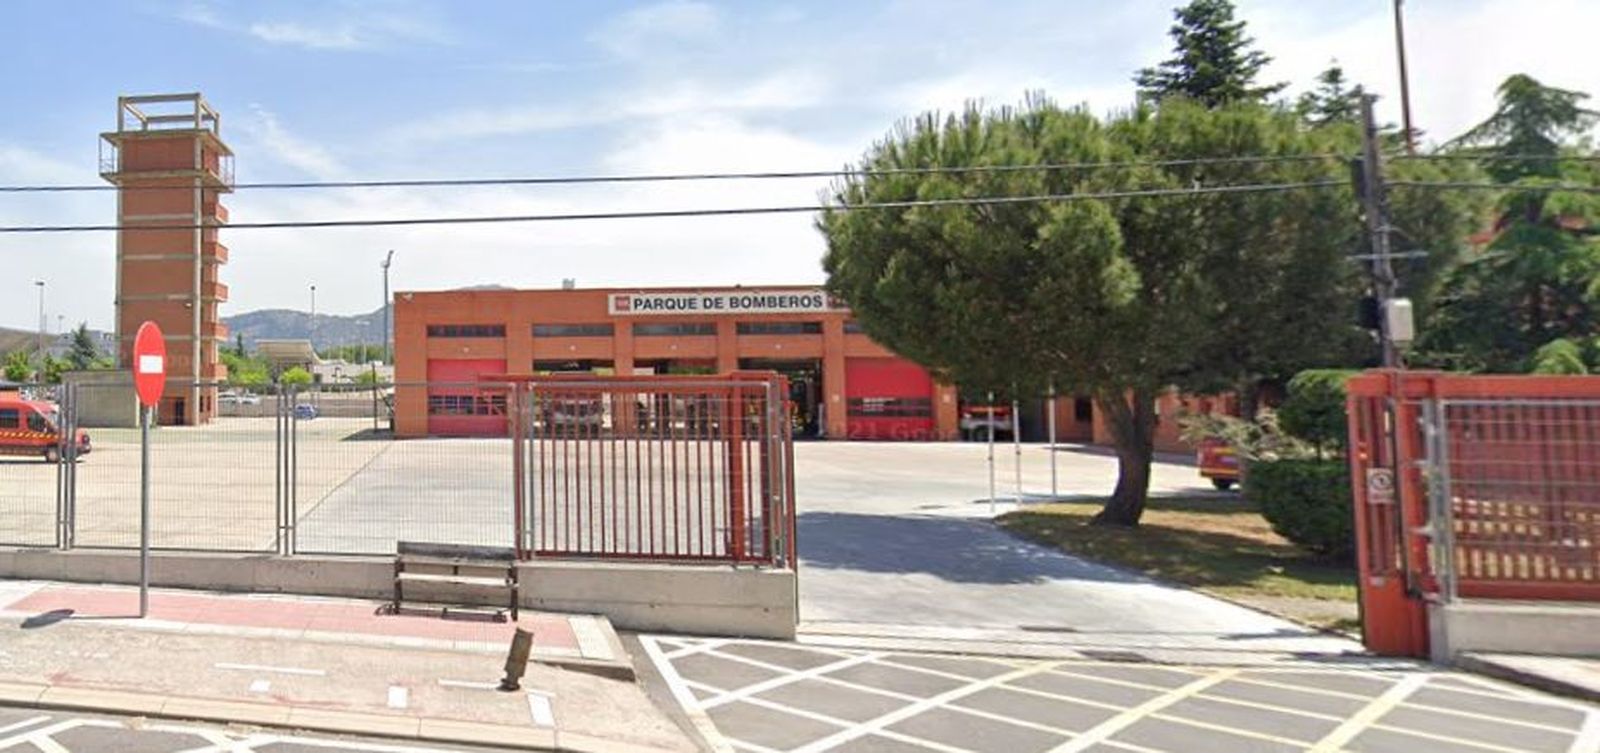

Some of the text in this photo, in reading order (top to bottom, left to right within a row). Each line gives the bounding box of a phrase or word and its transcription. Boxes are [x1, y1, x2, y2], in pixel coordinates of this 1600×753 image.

[633, 294, 823, 311] PARQUE DE BOMBEROS
